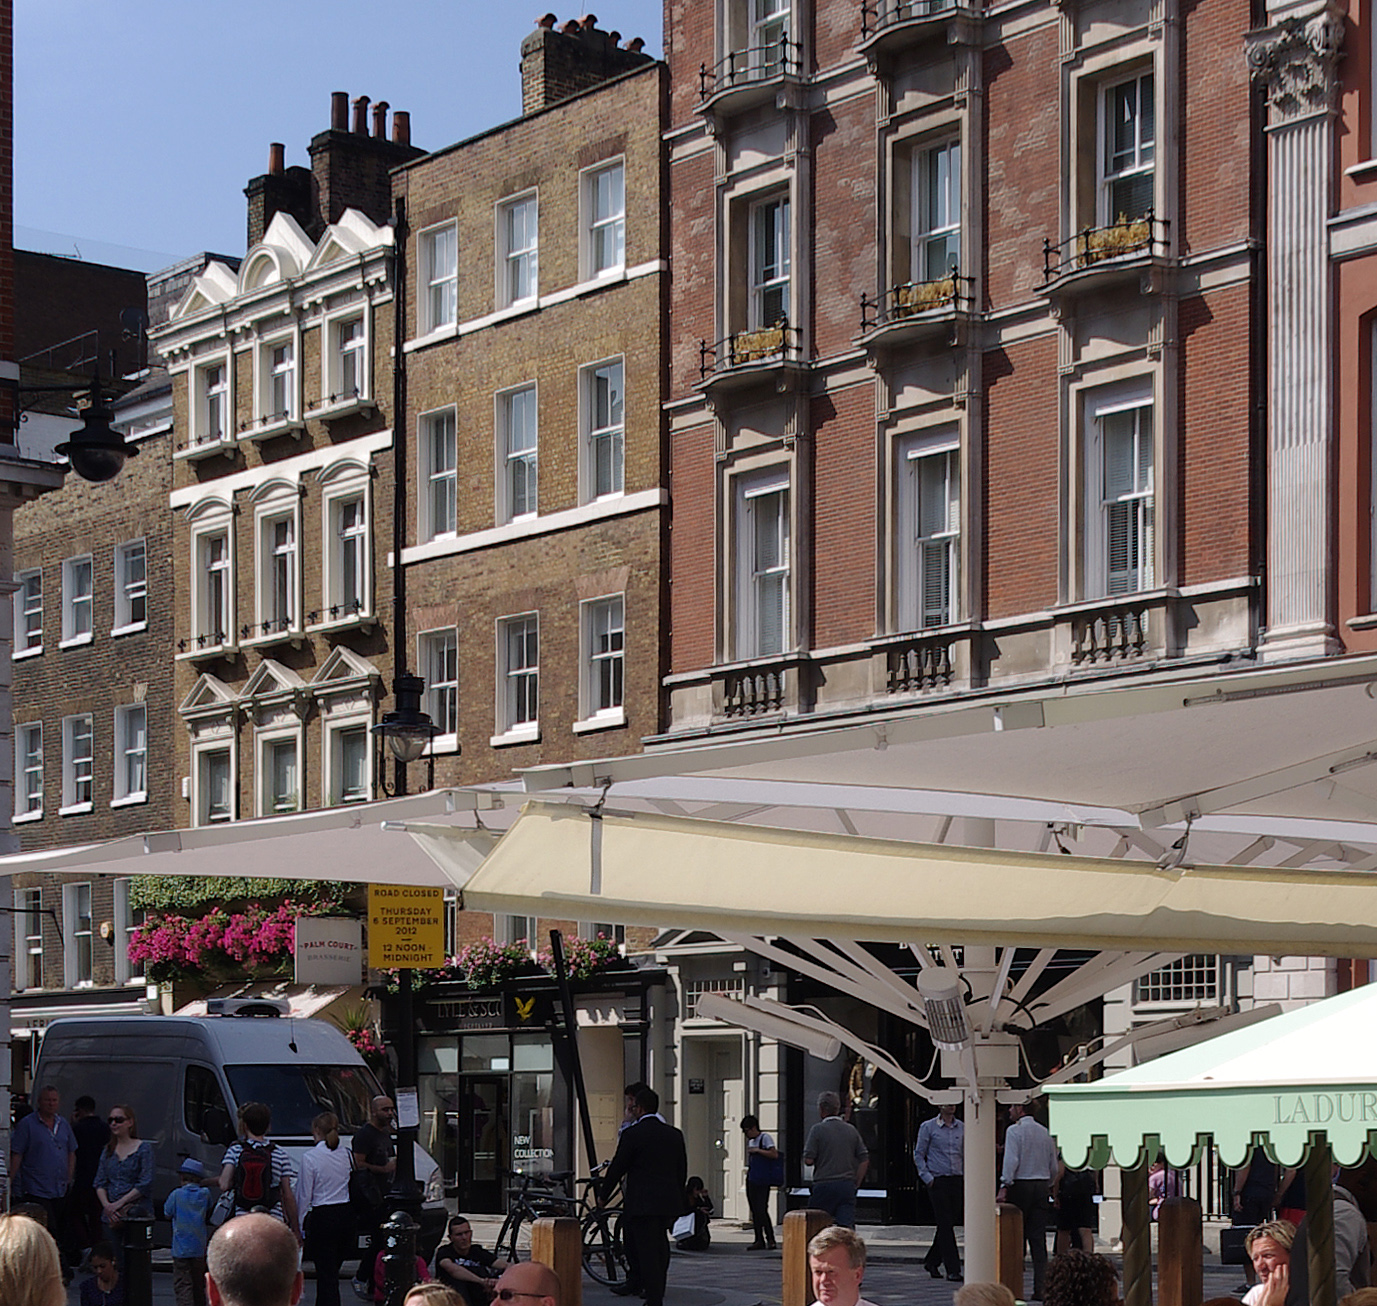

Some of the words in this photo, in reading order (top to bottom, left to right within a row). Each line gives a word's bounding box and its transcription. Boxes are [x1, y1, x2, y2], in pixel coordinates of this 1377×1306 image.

[374, 889, 399, 898] ROAD
[403, 889, 439, 898] CLOSED
[380, 907, 432, 915] THURSDAY
[373, 917, 379, 925] 6
[382, 917, 439, 925] SEPTEMBER
[395, 927, 417, 935] 2012
[304, 941, 325, 950] PALM
[327, 940, 355, 950] COURT
[383, 944, 392, 952] 12
[396, 944, 425, 952] NOON
[307, 954, 351, 963] BRASSERIE
[383, 953, 433, 962] MIDNIGHT
[437, 1002, 466, 1018] LYLE
[468, 1001, 479, 1018] &
[514, 1135, 531, 1145] NEW
